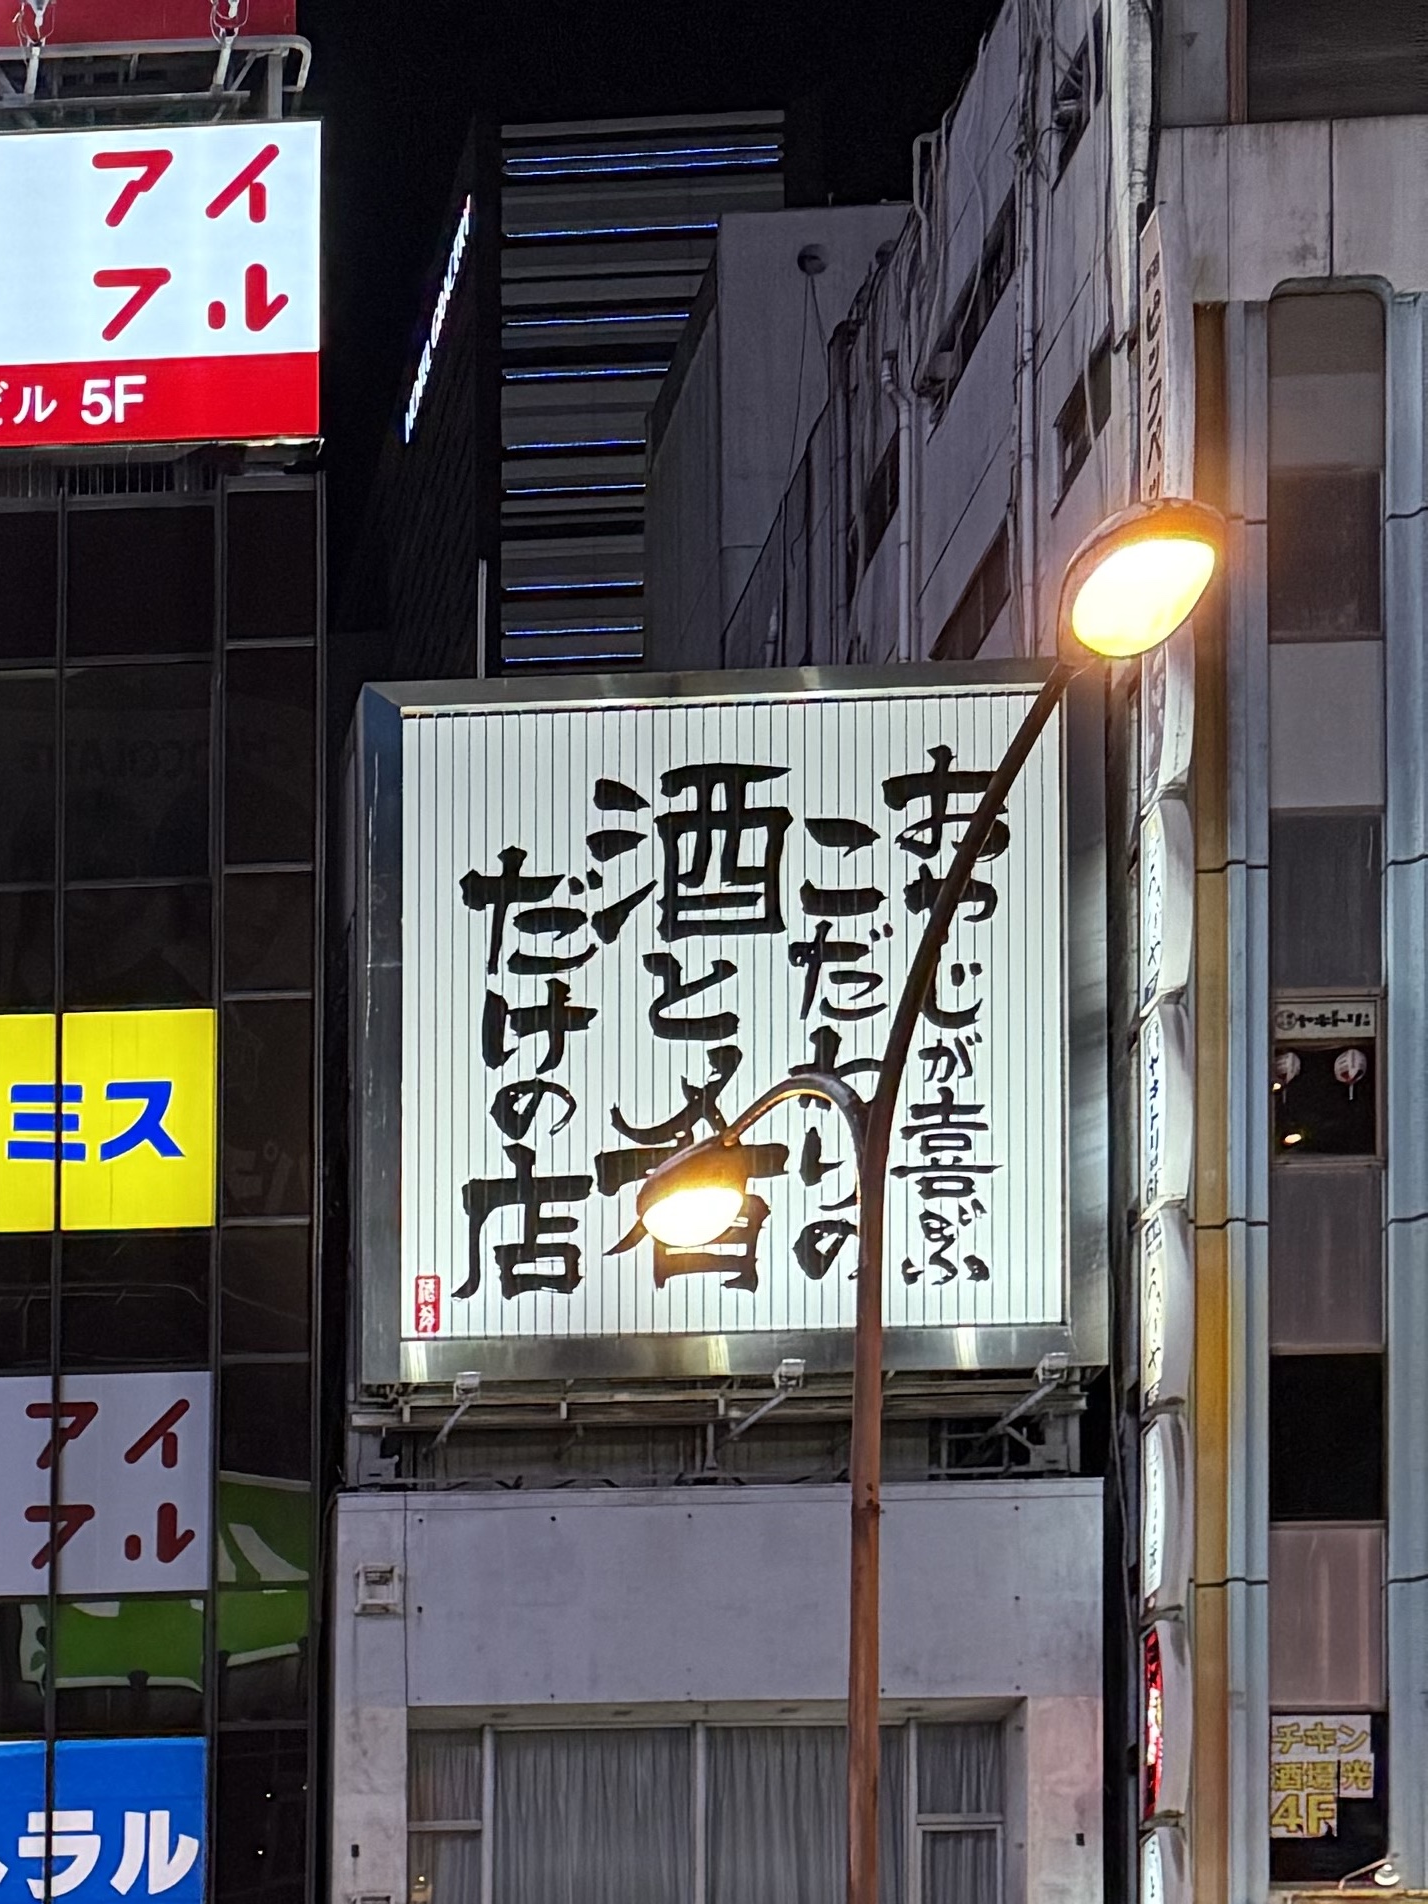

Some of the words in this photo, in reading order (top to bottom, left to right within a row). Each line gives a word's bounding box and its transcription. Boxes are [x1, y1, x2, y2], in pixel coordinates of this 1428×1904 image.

[91, 143, 280, 227] アイ
[92, 263, 289, 342] フル
[80, 374, 147, 427] 5F
[883, 744, 1010, 1285] おやじが喜ぶ
[451, 846, 602, 1301] だけの店
[1274, 1722, 1369, 1754] チキン
[1271, 1796, 1336, 1835] 4F
